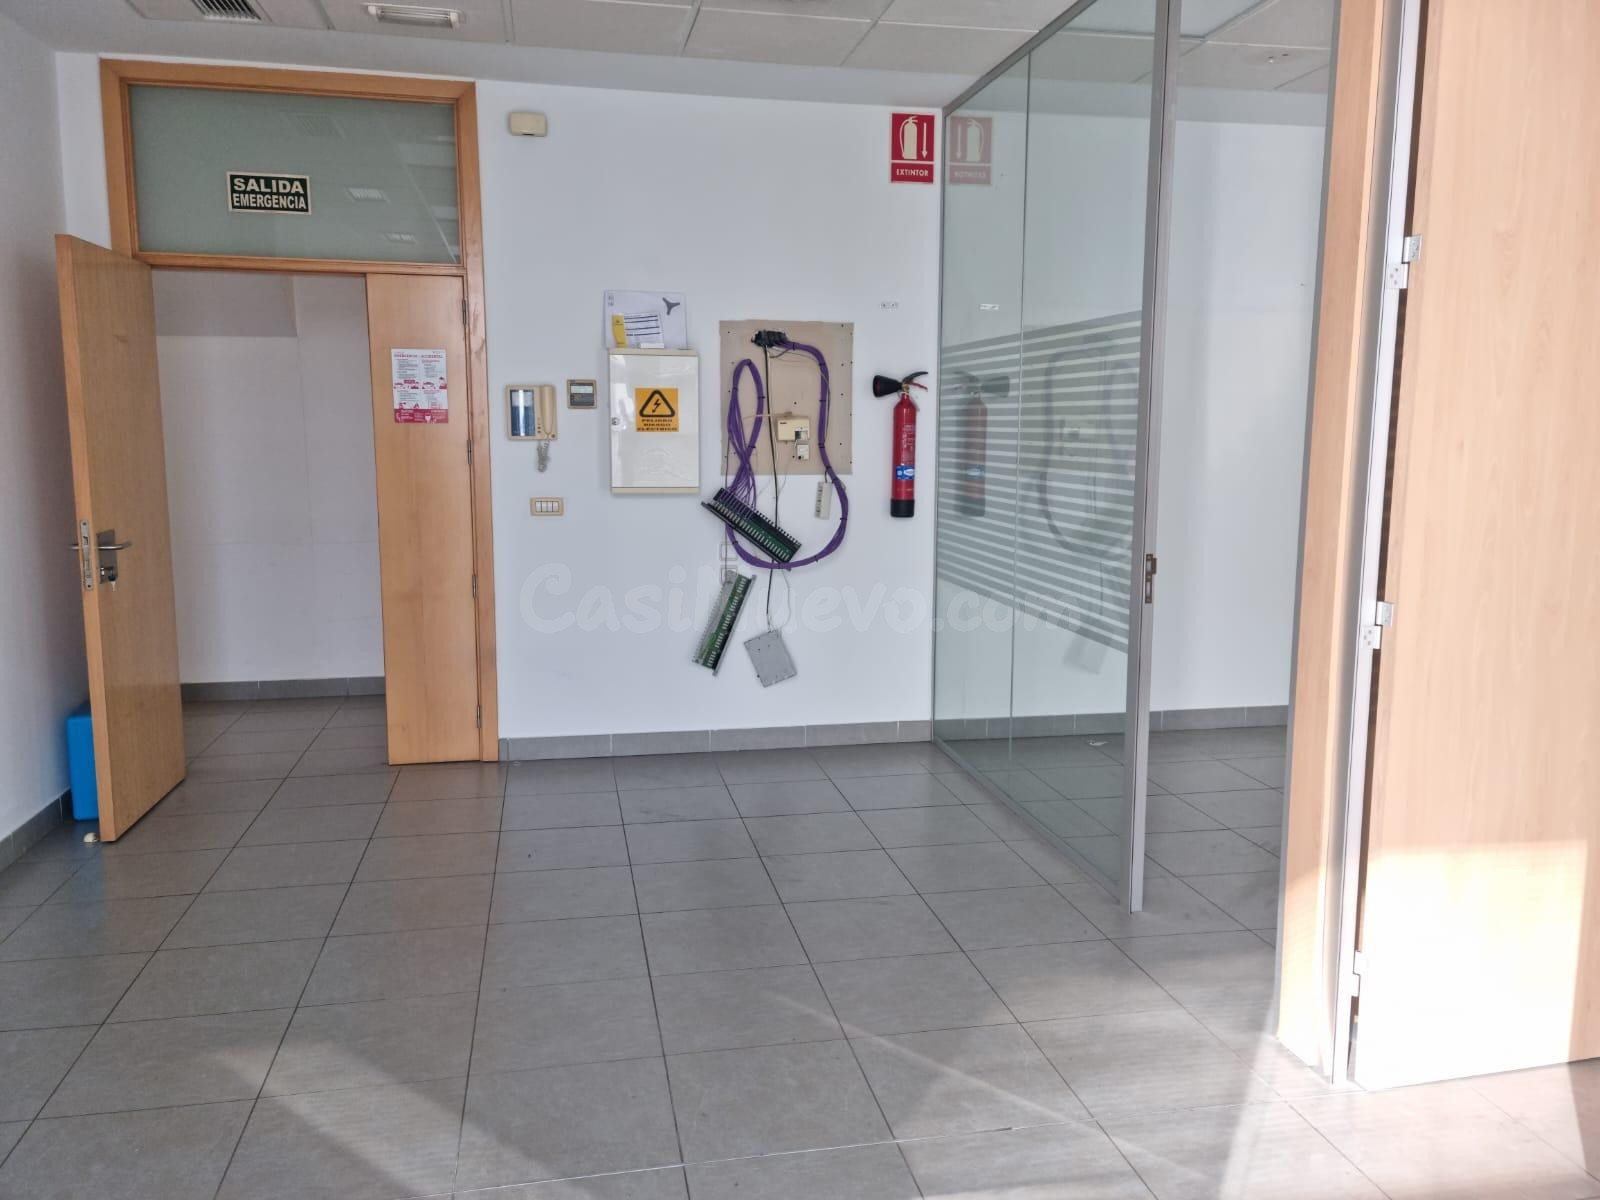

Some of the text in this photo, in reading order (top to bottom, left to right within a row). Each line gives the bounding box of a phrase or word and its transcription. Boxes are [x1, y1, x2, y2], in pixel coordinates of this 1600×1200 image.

[896, 168, 929, 177] EXTINTOR
[233, 177, 304, 194] SALIDA
[233, 193, 307, 209] EMERGENCIA
